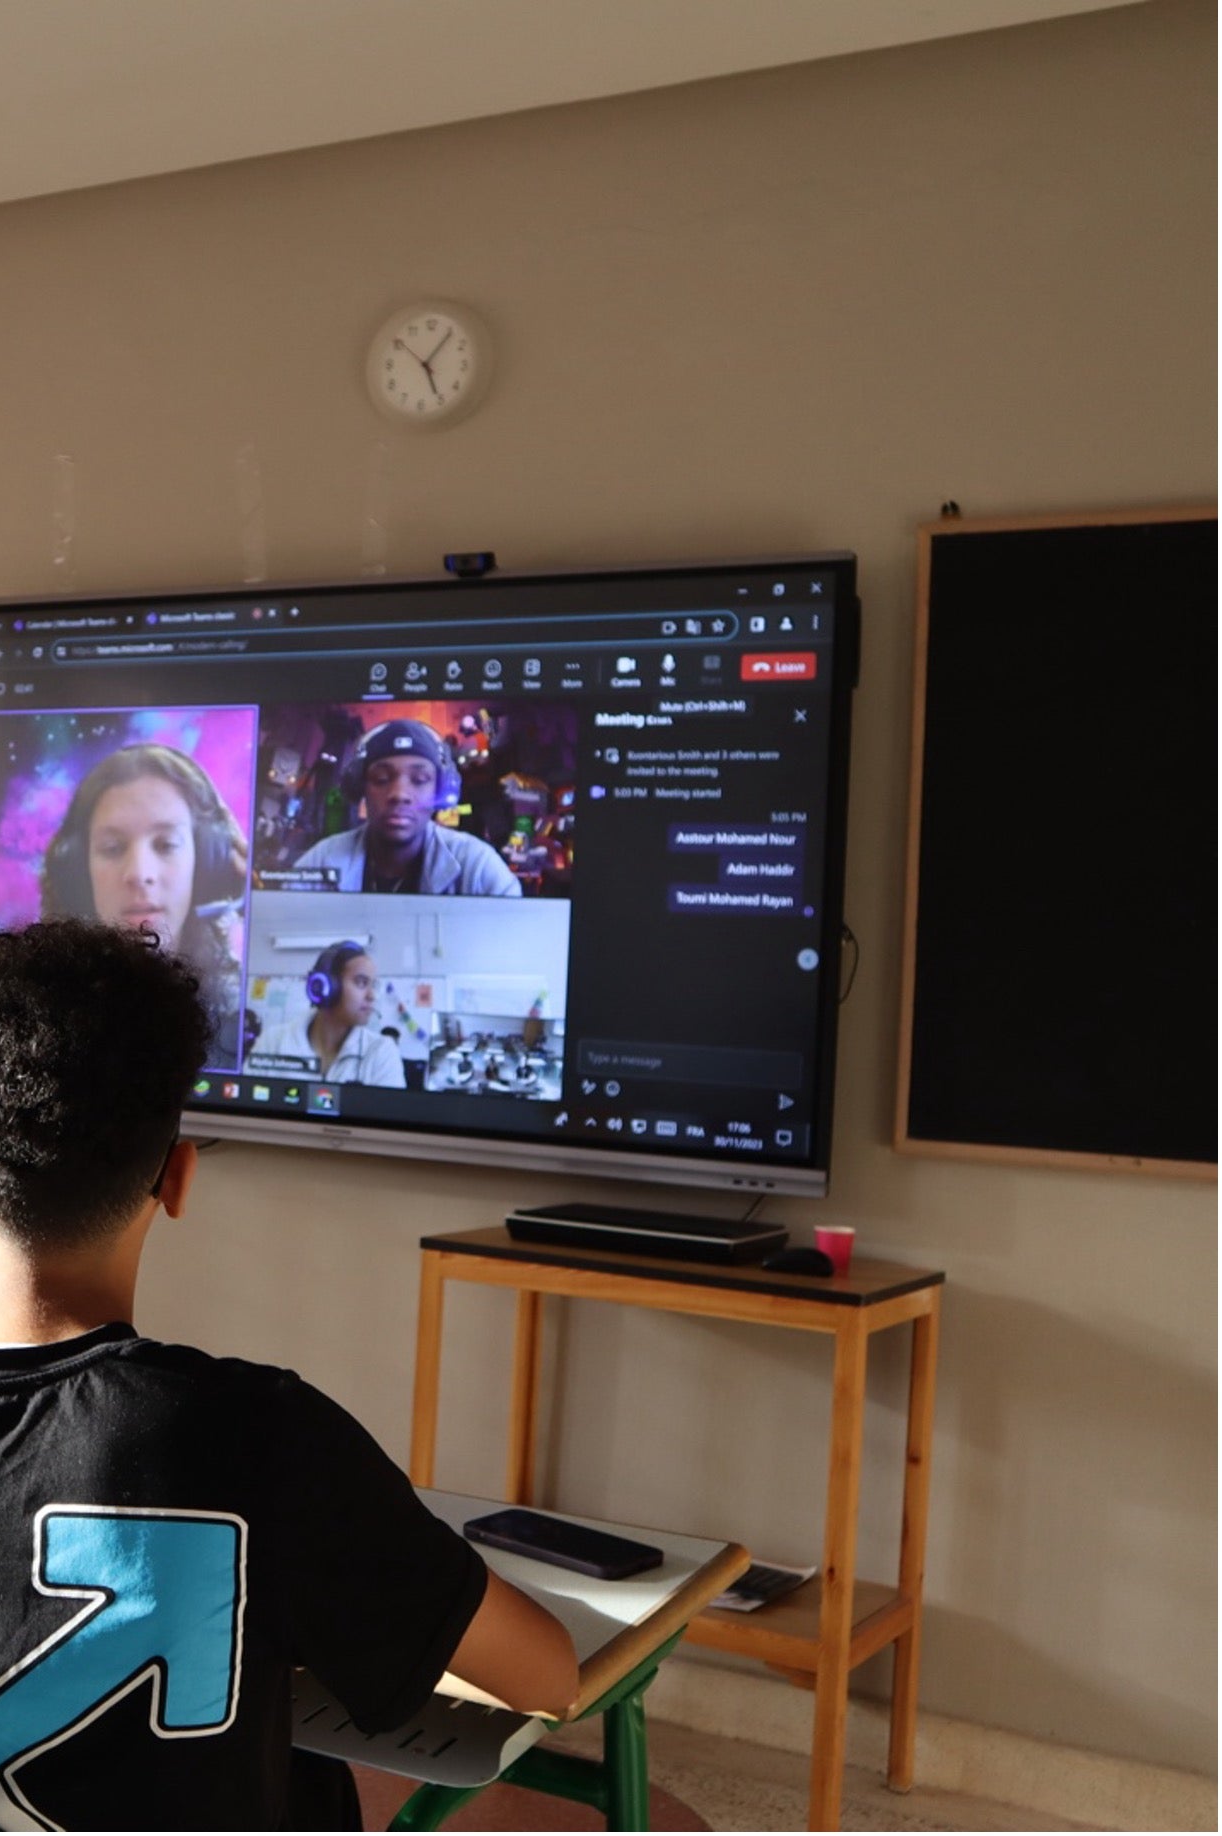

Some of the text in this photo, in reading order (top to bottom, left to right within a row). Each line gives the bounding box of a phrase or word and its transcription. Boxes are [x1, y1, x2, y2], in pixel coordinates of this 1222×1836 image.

[160, 610, 192, 623] Microsoft
[192, 610, 214, 622] Teams
[774, 660, 807, 674] Leave
[481, 680, 504, 691] React
[522, 679, 542, 690] View
[561, 678, 583, 690] More
[610, 677, 642, 688] Camera
[659, 675, 676, 687] Mic
[368, 683, 388, 693] Chat
[403, 682, 428, 693] People
[659, 699, 747, 713] Mute (Ctrl+Shift+M)
[595, 712, 645, 728] Meeting
[677, 749, 703, 761] Smith
[703, 749, 720, 761] and
[729, 749, 757, 761] others
[757, 751, 780, 761] were
[626, 765, 656, 777] invited
[667, 765, 682, 777] the
[633, 787, 648, 799] PM
[655, 787, 691, 801] Meeting
[691, 787, 722, 799] started
[790, 812, 807, 824] PM
[715, 831, 768, 846] Mohamed
[769, 832, 796, 846] Nour
[726, 861, 759, 876] Adam
[676, 890, 794, 910] Toumi Mohamed Rayan
[588, 1051, 611, 1067] Type
[620, 1056, 662, 1070] message
[686, 1125, 706, 1138] FRA
